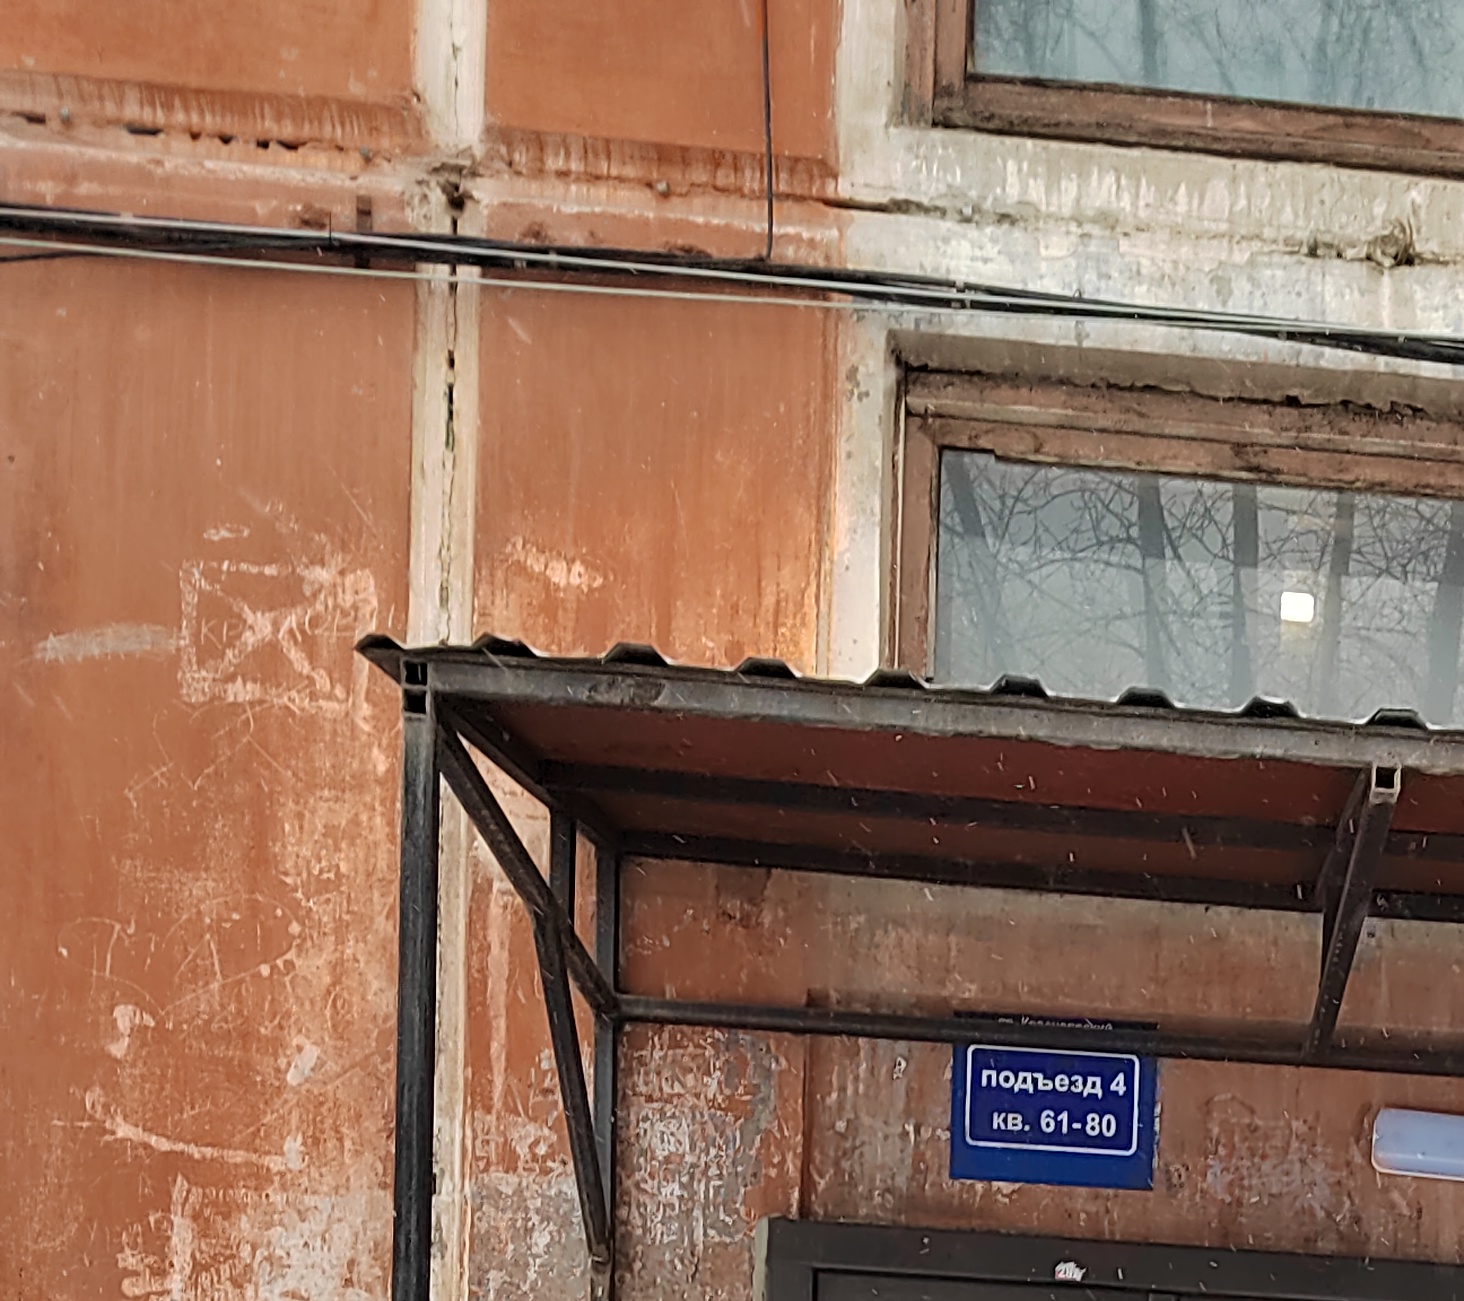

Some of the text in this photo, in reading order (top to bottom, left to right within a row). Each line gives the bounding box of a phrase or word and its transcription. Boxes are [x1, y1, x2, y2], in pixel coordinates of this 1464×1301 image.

[981, 1068, 1126, 1099] подъезд 4
[992, 1109, 1117, 1137] кв. 61-80
